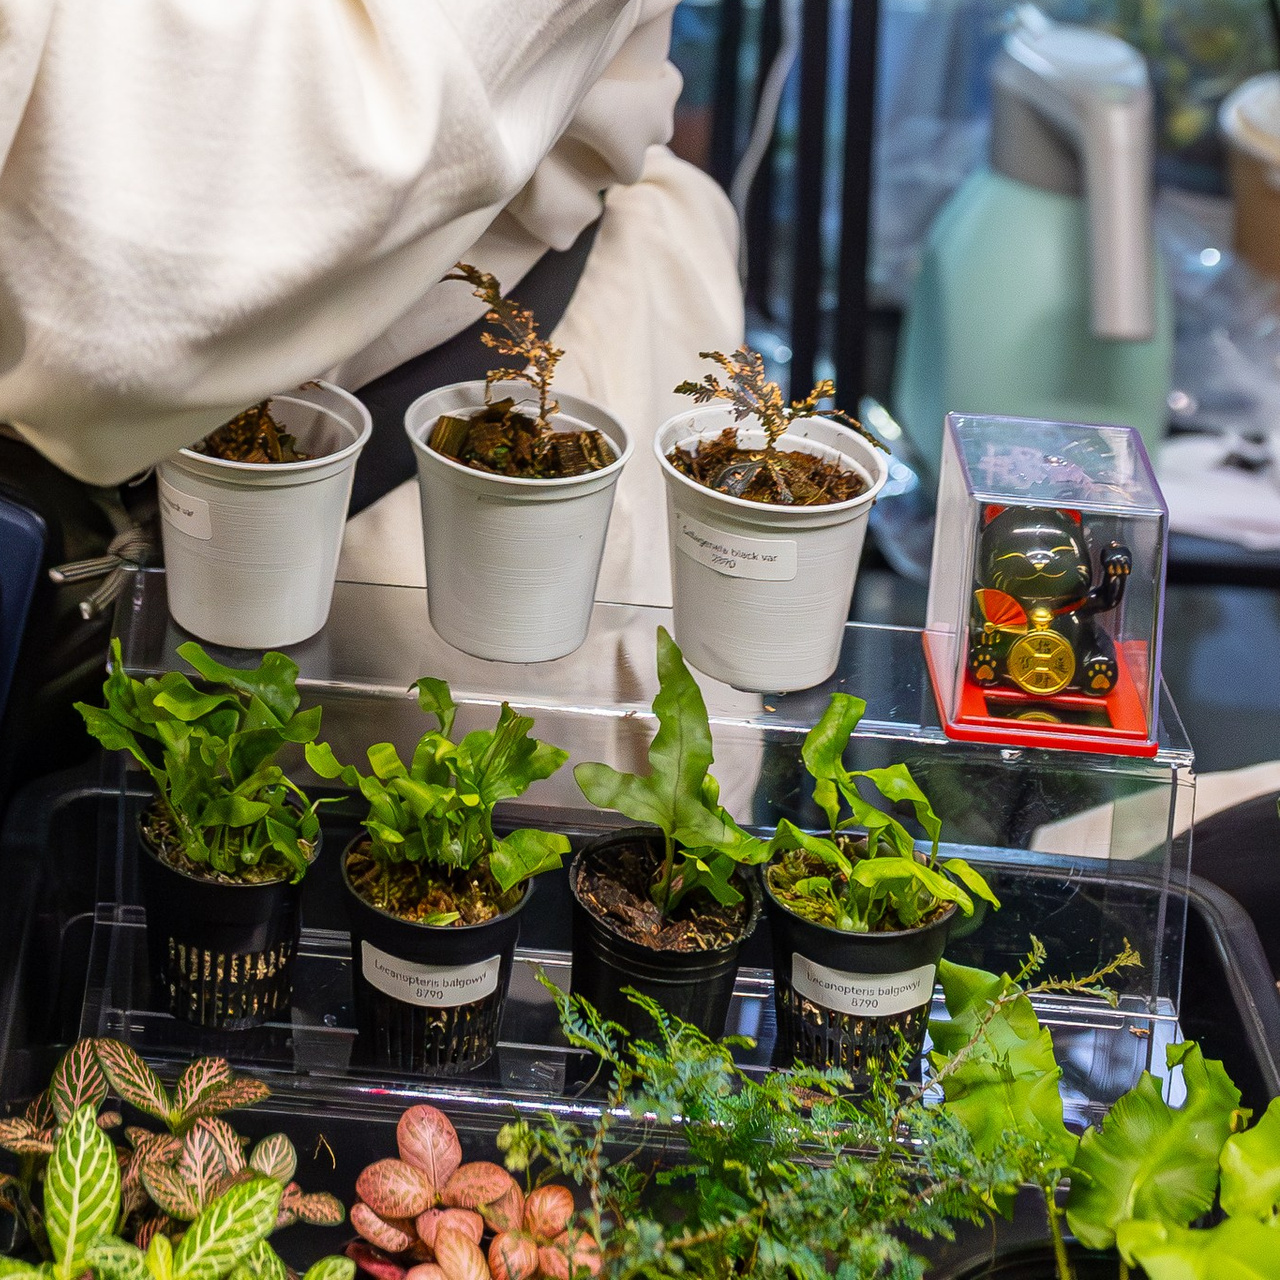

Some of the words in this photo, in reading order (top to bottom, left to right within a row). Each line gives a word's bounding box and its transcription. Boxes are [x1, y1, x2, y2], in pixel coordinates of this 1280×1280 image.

[731, 547, 758, 560] black
[374, 959, 440, 987] Lecanopteris
[807, 971, 875, 996] Lecanopteris
[416, 988, 444, 1000] 8790
[851, 997, 879, 1009] 8790
